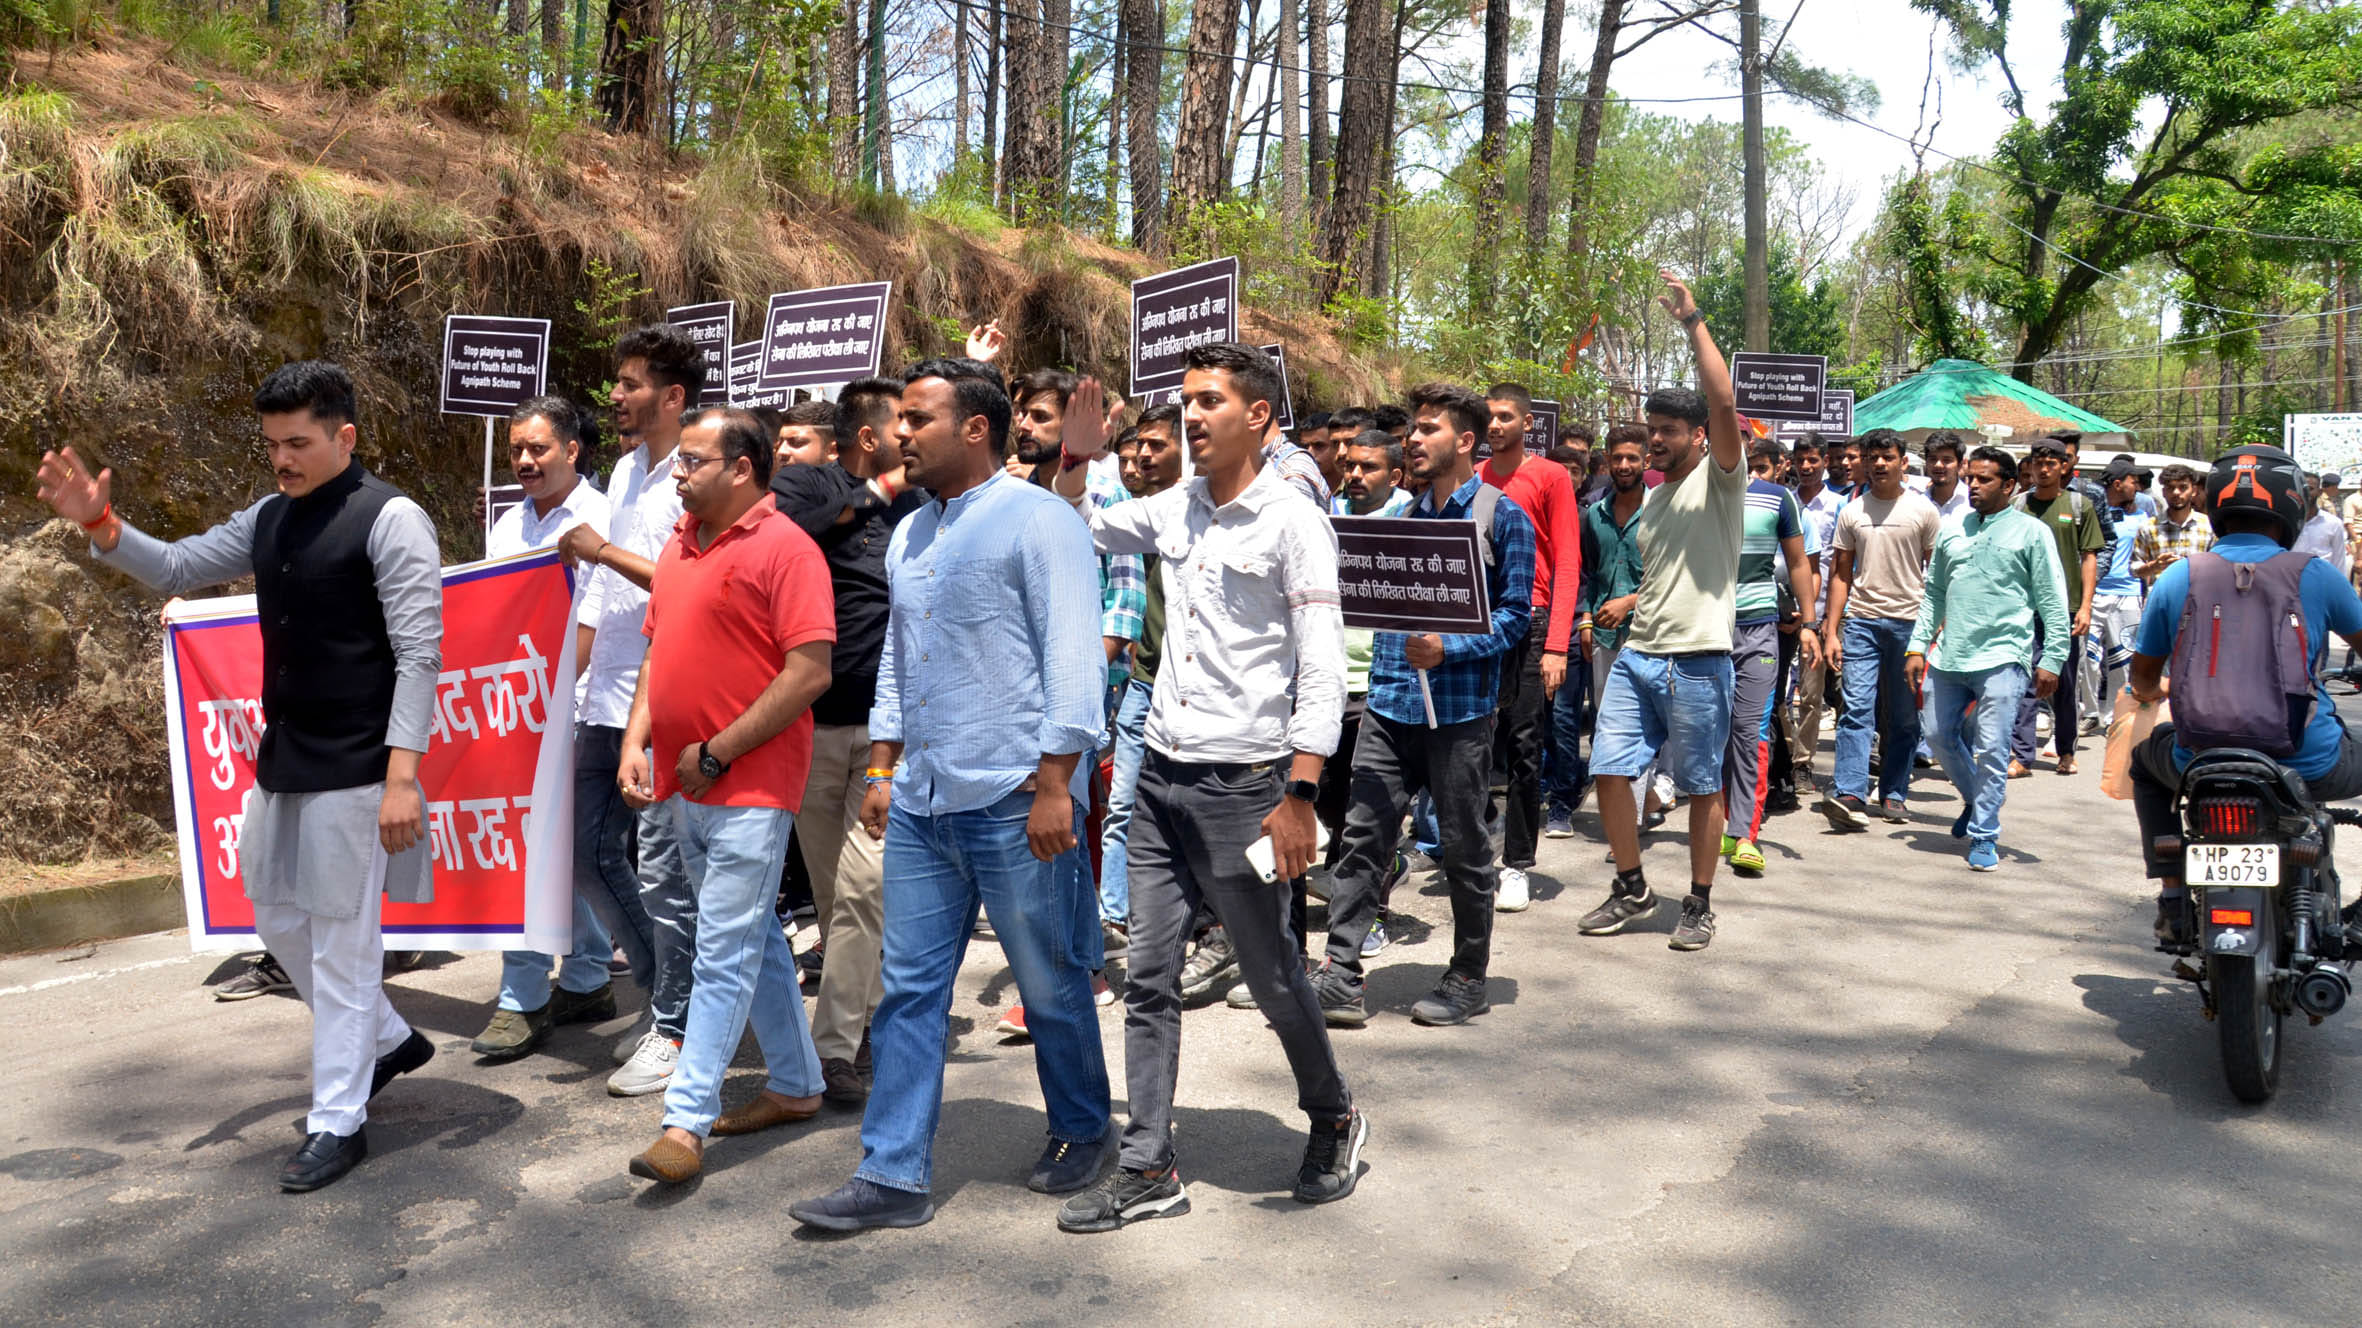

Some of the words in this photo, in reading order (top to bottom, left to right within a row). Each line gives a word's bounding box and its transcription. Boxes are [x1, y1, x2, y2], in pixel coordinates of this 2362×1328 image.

[1168, 306, 1187, 325] योजना
[1200, 297, 1210, 317] की
[1212, 298, 1226, 314] जाए
[806, 317, 830, 333] योजना
[844, 313, 856, 330] की
[857, 315, 873, 329] जाए
[464, 345, 478, 358] Stop
[480, 346, 505, 359] playing
[507, 348, 523, 359] with
[786, 343, 796, 360] की
[843, 338, 854, 355] ली
[854, 341, 870, 355] जाए
[1141, 342, 1154, 361] सेना
[1154, 339, 1162, 358] की
[1163, 334, 1184, 356] लिखित
[451, 359, 470, 370] Future
[472, 361, 479, 370] of
[481, 361, 500, 372] Youth
[501, 363, 515, 373] Roll
[517, 364, 536, 375] Back
[461, 375, 490, 388] Agnipath
[492, 377, 521, 389] Scheme
[1750, 372, 1764, 380] Stop
[1765, 373, 1789, 382] playing
[1767, 382, 1784, 390] Youth
[1800, 384, 1817, 392] Back
[1748, 392, 1776, 401] Agnipath
[1778, 393, 1804, 402] Scheme
[1376, 552, 1406, 571] योजना
[1410, 558, 1424, 573] रद्द
[1427, 554, 1442, 573] की
[1445, 558, 1466, 575] जाए
[1358, 580, 1372, 599] की
[1372, 580, 1406, 601] लिखित
[1406, 582, 1434, 602] परीक्षा
[1436, 583, 1449, 603] ली
[1450, 588, 1470, 604] जाए
[470, 634, 552, 737] करो
[459, 798, 517, 872] रद्द
[2206, 847, 2229, 863] HP
[2241, 847, 2264, 863] 23
[2205, 865, 2267, 881] A9079
